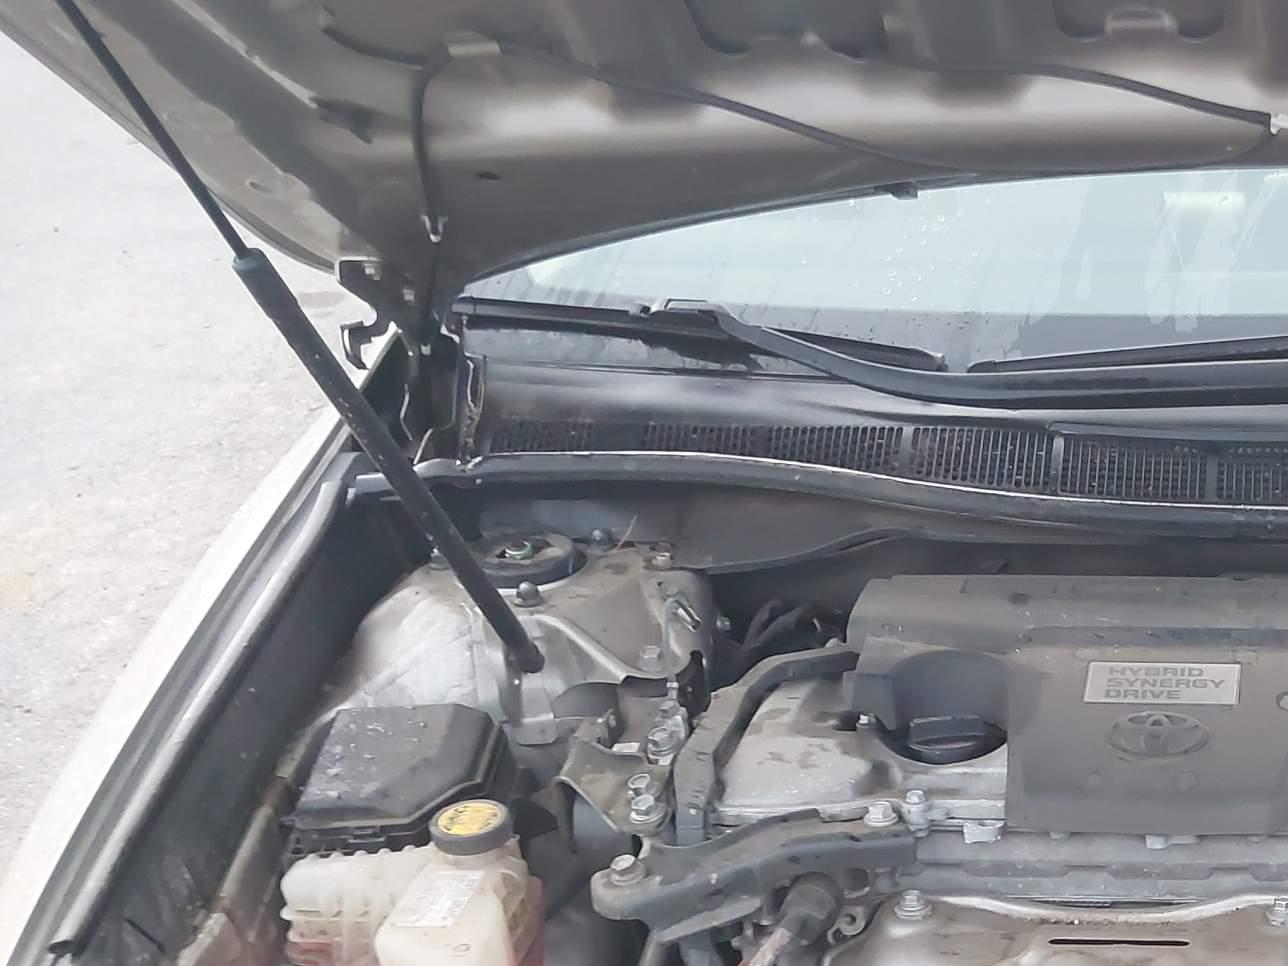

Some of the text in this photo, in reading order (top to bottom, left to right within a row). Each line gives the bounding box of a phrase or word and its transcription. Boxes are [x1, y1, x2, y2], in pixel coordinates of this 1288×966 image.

[1107, 666, 1205, 677] HYBRID
[1105, 677, 1226, 689] SYNERGY
[1103, 688, 1183, 700] DRIVE
